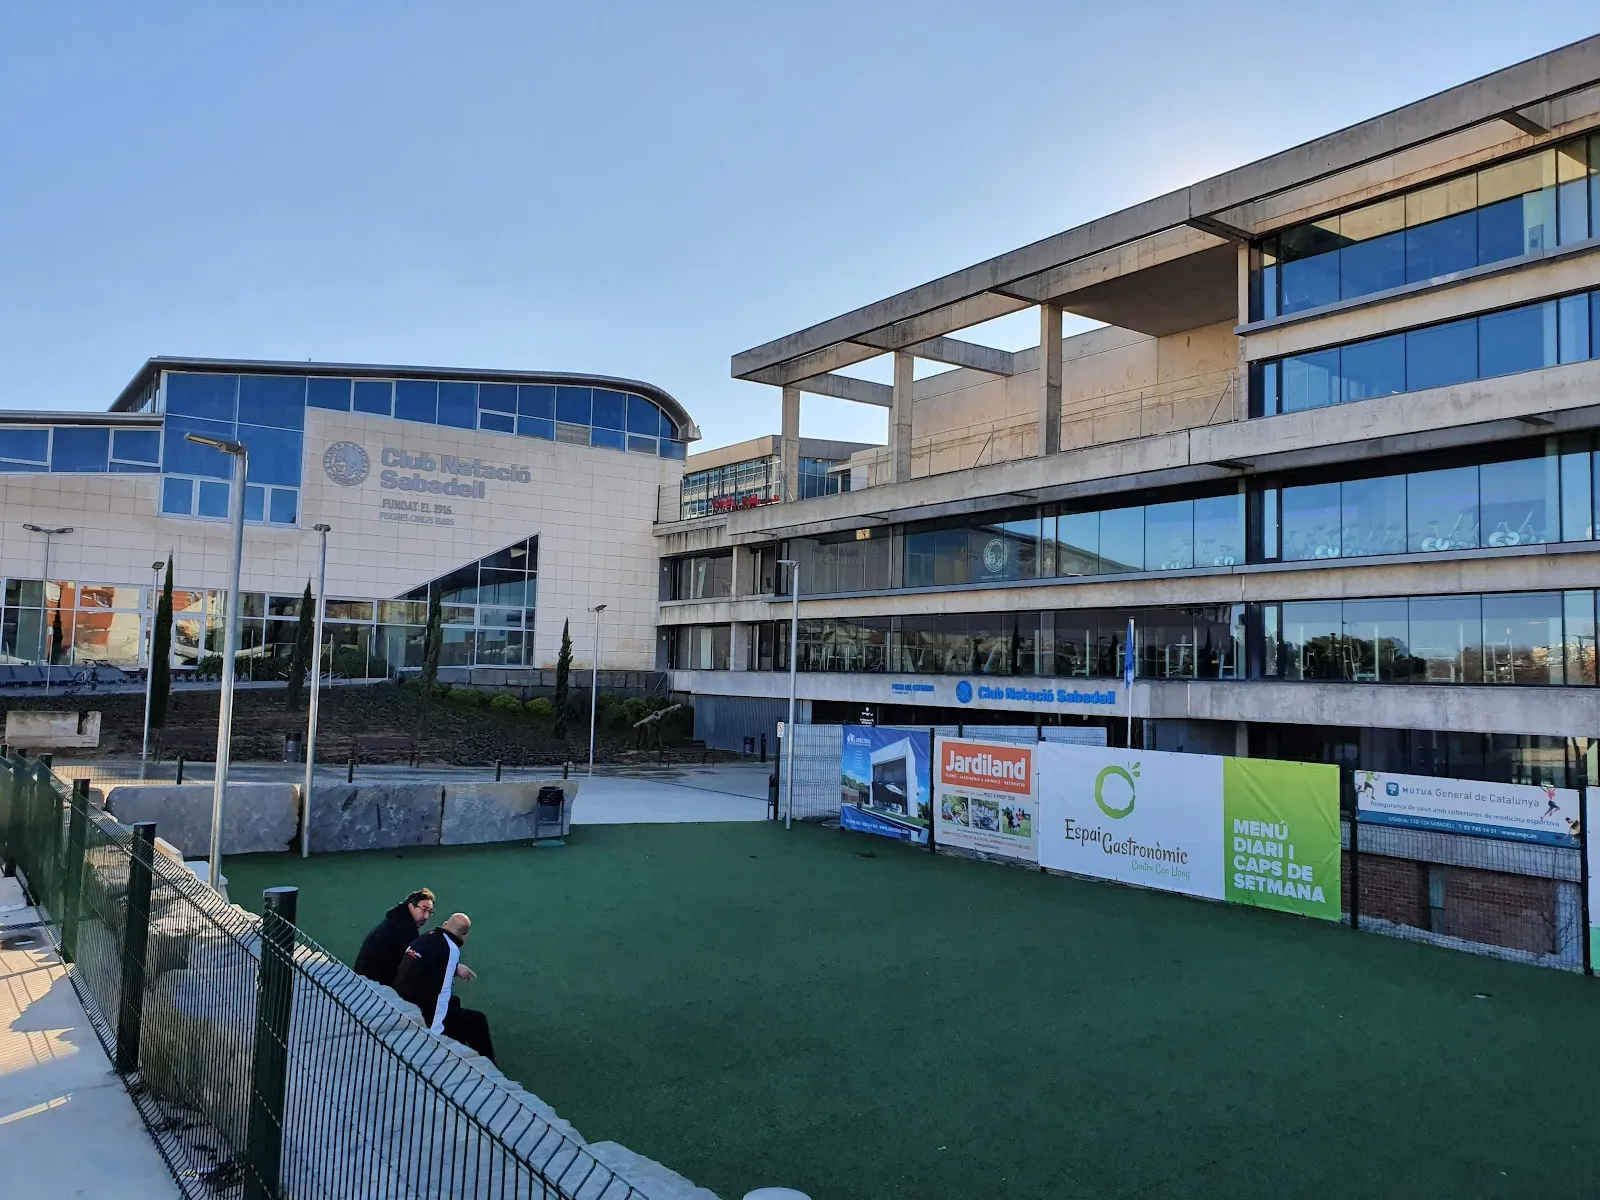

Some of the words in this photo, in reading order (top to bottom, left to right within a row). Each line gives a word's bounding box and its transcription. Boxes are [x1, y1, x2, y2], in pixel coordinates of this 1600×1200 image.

[381, 447, 436, 472] Club
[441, 455, 532, 483] Natació
[380, 470, 486, 499] Sabadell
[382, 498, 419, 511] FUNDAT
[420, 502, 431, 513] EL
[433, 503, 452, 515] 1916
[978, 686, 1004, 700] Club
[1005, 687, 1055, 703] Natació
[1056, 688, 1116, 704] Sabadell
[945, 750, 1026, 780] Jardiland
[1435, 788, 1472, 800] General
[1474, 792, 1487, 802] de
[1489, 793, 1540, 808] Catalunya
[1370, 800, 1407, 810] Assegurança
[1407, 802, 1416, 810] de
[1416, 804, 1431, 813] salut
[1432, 806, 1447, 814] amb
[1447, 807, 1483, 818] cobertures
[1493, 813, 1525, 823] medicina
[1526, 817, 1560, 827] esportiva
[1430, 820, 1455, 829] SABADELL
[1065, 818, 1101, 846] Espai
[1102, 832, 1188, 865] Gastronòmic
[1233, 818, 1289, 840] MENÚ
[1233, 836, 1284, 859] DIARI
[1288, 844, 1294, 860] I
[1131, 860, 1154, 873] Centre
[1155, 863, 1170, 875] Can
[1171, 866, 1190, 881] Llong
[1233, 855, 1283, 877] CAPS
[1287, 862, 1313, 882] DE
[1233, 873, 1326, 904] SETMANA
